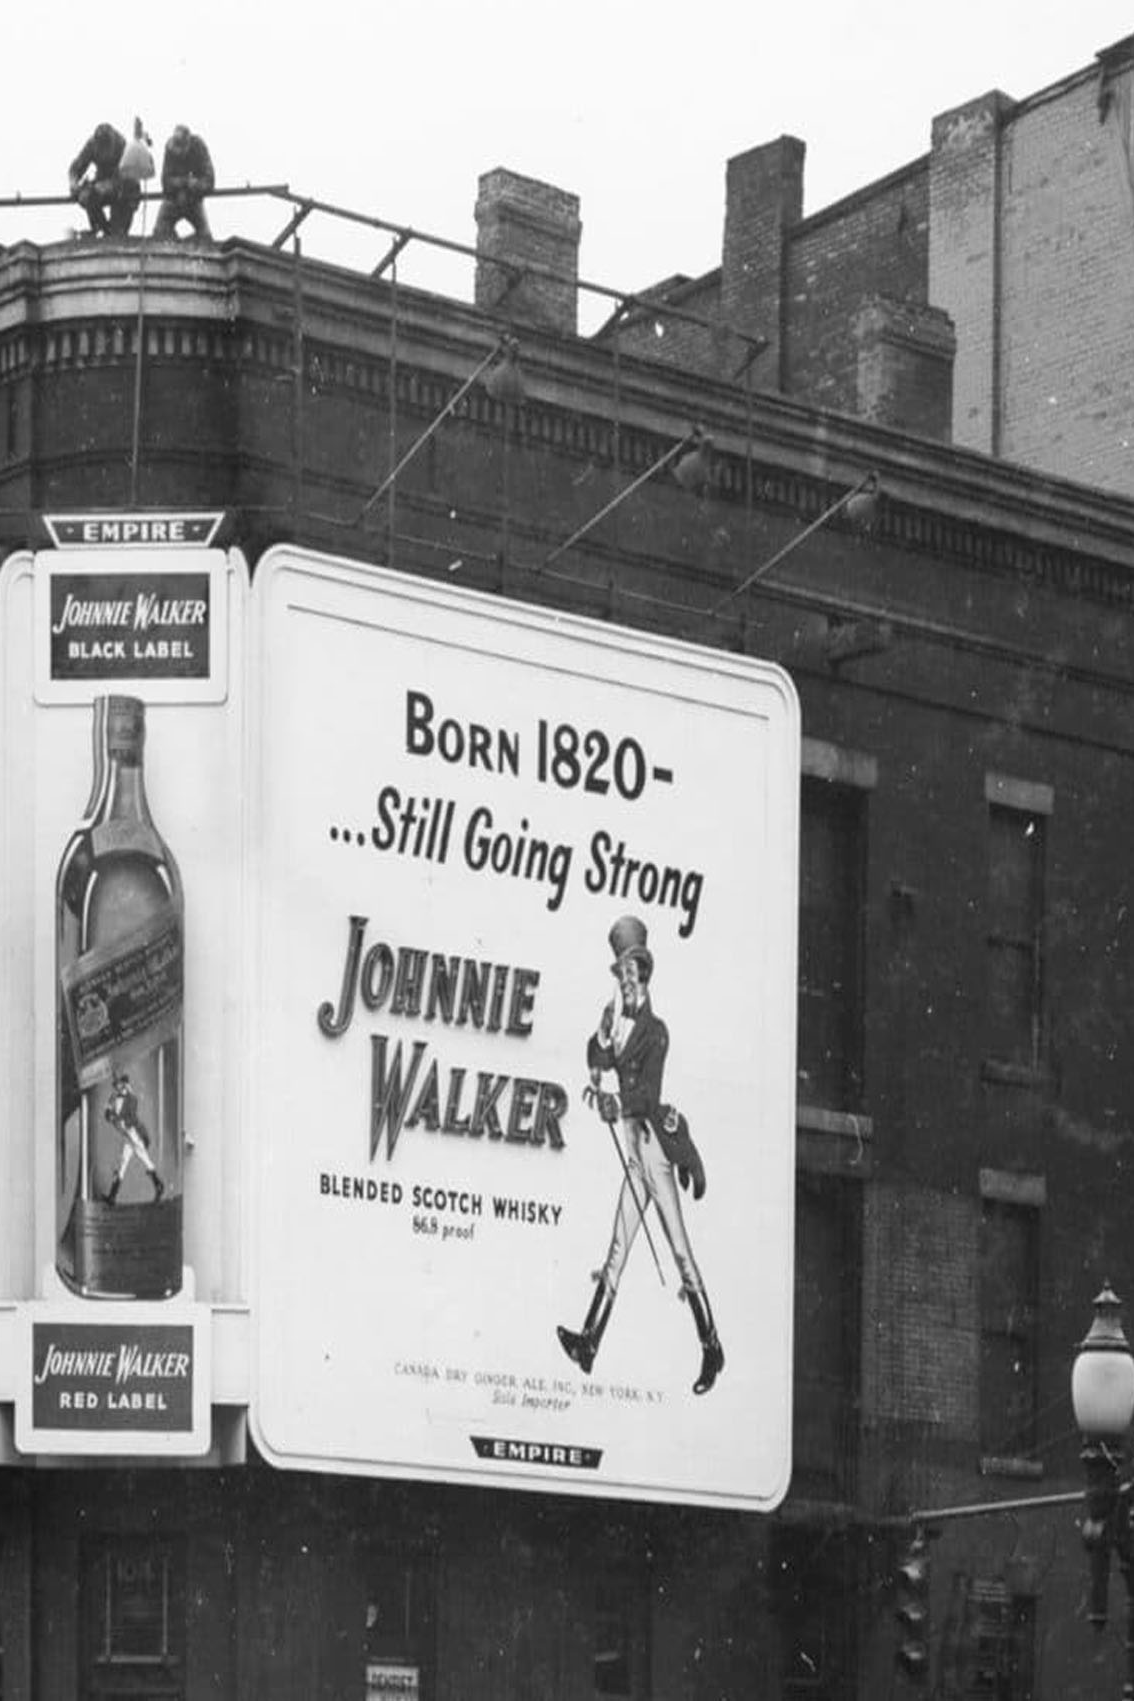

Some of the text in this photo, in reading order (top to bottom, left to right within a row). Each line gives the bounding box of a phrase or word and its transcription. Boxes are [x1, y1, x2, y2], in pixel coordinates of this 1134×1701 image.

[83, 522, 185, 541] EMPIRE
[52, 593, 207, 634] JOHNNIE WALKER
[68, 641, 194, 659] BLACK LABEL
[406, 690, 520, 777] BORN
[464, 806, 573, 912] Going
[584, 830, 704, 939] Strong
[317, 914, 540, 1040] JOHNNIE
[369, 1033, 569, 1164] WALKER
[320, 1172, 563, 1226] BLENDED SCOTCH WHISKY
[442, 1222, 475, 1241] proof
[34, 1344, 190, 1384] JOHNNIE WALKER
[60, 1392, 167, 1410] RED LABEL
[493, 1441, 583, 1465] EMPIRE
